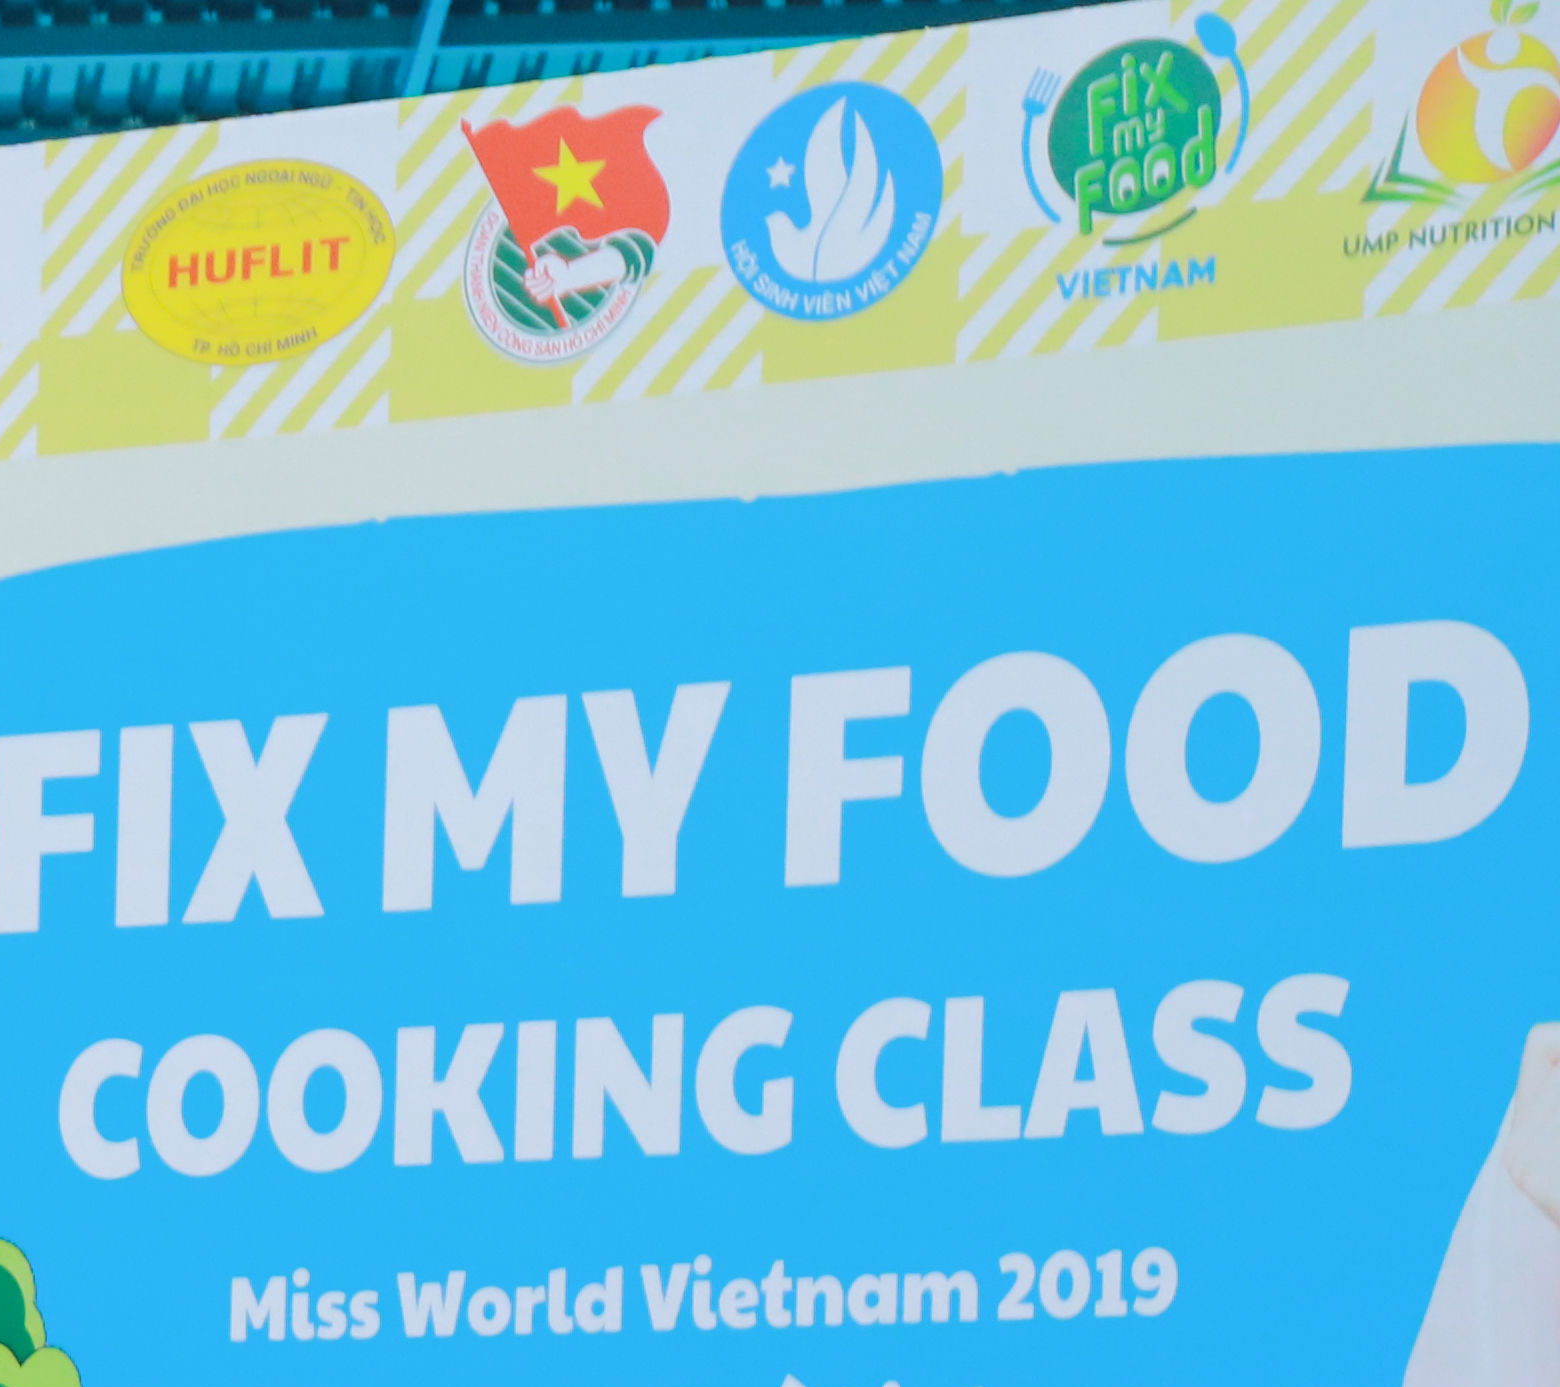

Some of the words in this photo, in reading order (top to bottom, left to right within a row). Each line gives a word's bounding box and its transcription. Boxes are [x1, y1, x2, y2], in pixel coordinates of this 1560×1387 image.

[1113, 106, 1166, 157] my
[167, 235, 351, 289] HUFLIT
[753, 272, 800, 312] SINH
[896, 210, 933, 266] NAM
[1343, 231, 1399, 257] UMP
[1409, 210, 1557, 250] NUTRITION
[1056, 255, 1216, 301] VIETNAM
[383, 682, 730, 911] MY
[785, 621, 1529, 886] FOOD
[59, 1006, 793, 1179] COOKING
[836, 975, 1351, 1148] CLASS
[231, 1269, 380, 1341] Miss
[398, 1267, 623, 1336] World
[641, 1255, 978, 1330] Vietnam
[998, 1248, 1178, 1319] 2019
